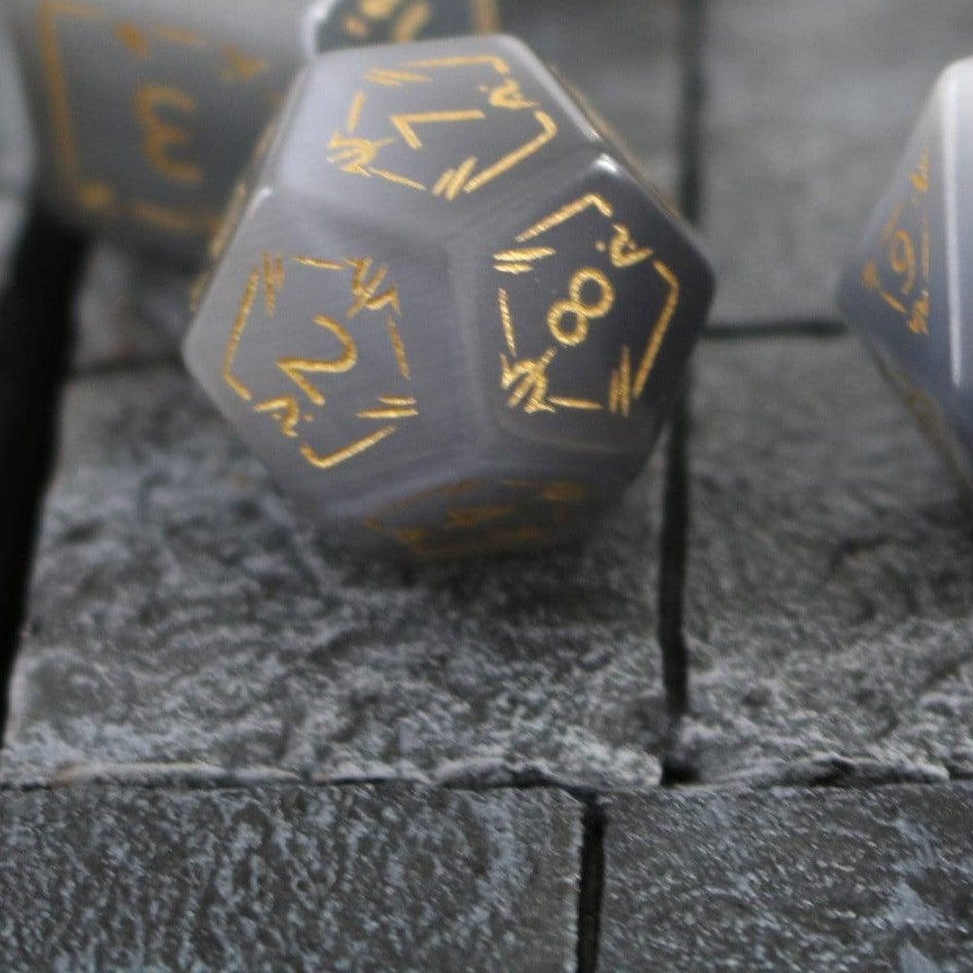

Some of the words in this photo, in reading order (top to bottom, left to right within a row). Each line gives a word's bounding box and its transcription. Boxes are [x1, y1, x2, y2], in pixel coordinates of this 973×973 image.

[134, 81, 200, 184] 3
[546, 266, 615, 347] 8
[275, 313, 358, 407] 2
